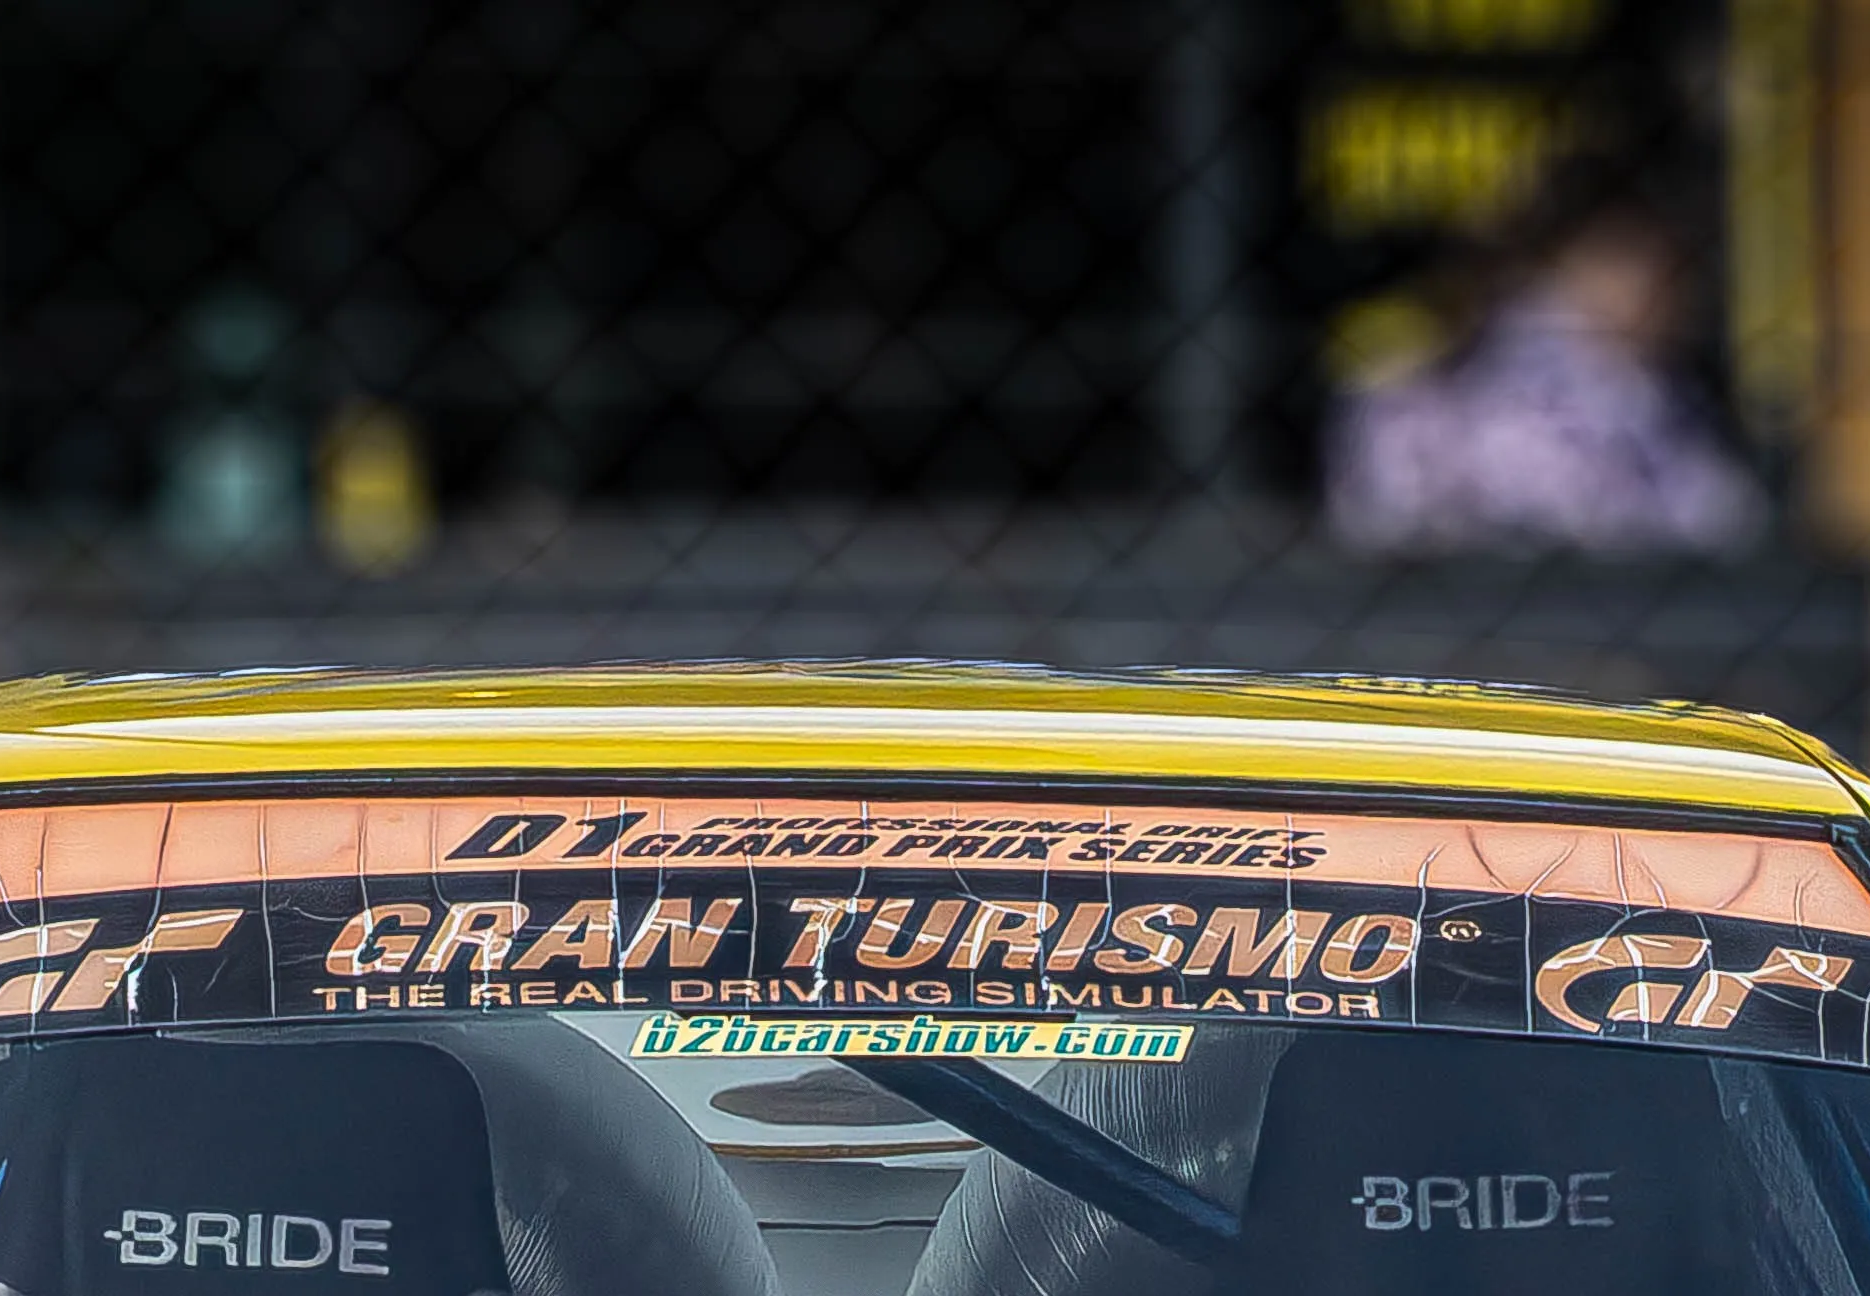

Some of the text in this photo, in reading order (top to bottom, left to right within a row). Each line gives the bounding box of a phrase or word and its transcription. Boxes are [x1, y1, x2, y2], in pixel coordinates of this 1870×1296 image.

[444, 812, 648, 861] D1
[621, 831, 1330, 869] GRAND PRIX SERIES
[1141, 824, 1325, 842] DRIFT
[326, 896, 1417, 983] GRAN TURISMO
[311, 978, 1380, 1018] THE REAL DRIVING SIMULATOR
[1352, 1169, 1617, 1231] BRIDE
[104, 1208, 393, 1278] BRIDE
